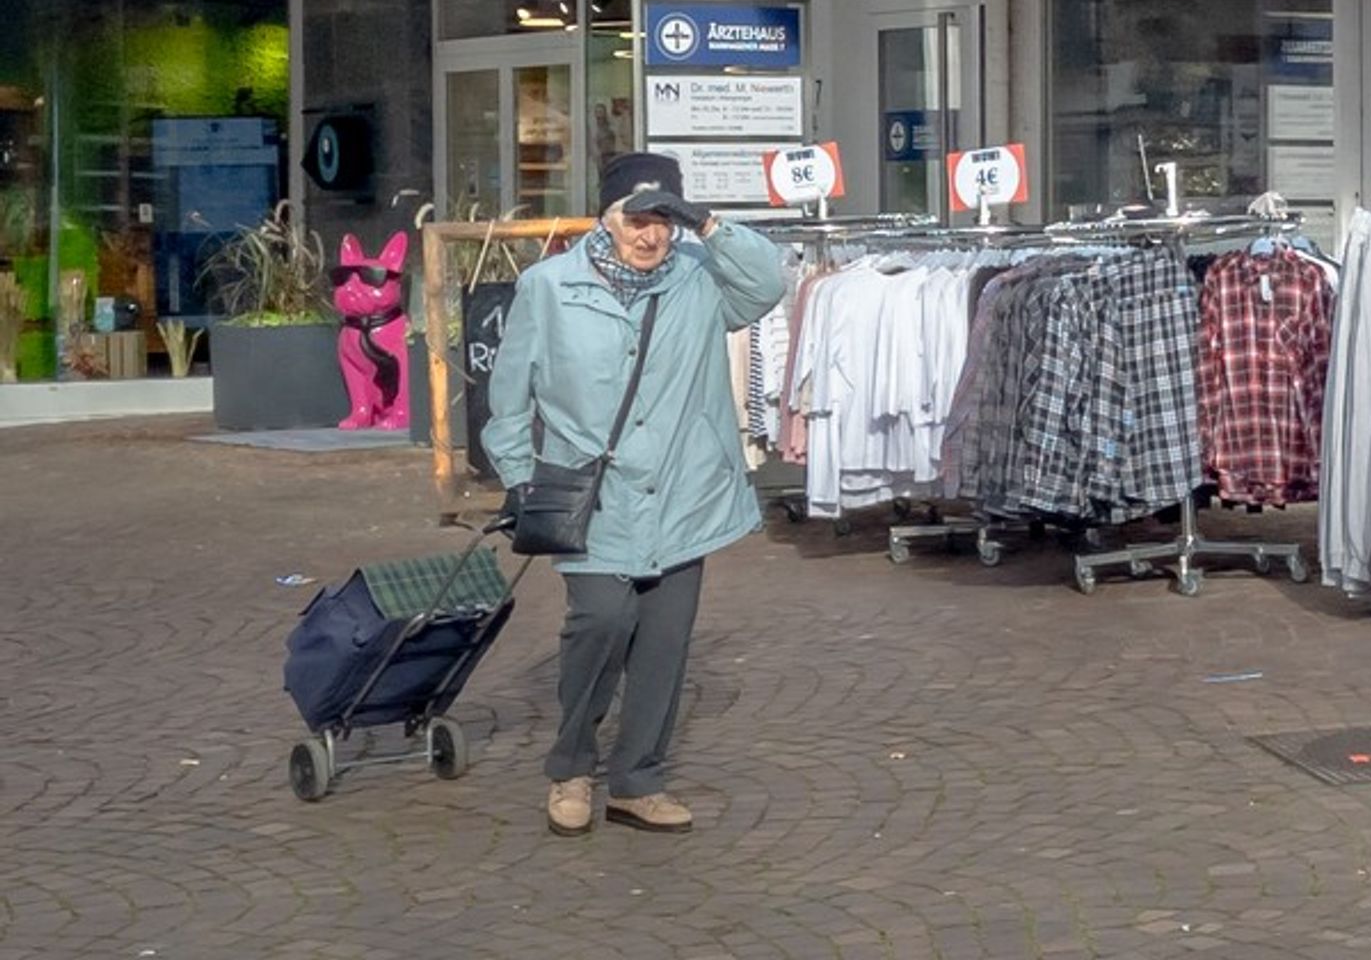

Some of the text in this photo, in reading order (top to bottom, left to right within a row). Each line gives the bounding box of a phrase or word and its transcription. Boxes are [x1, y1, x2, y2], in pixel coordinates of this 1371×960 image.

[707, 21, 786, 41] ÄRZTEHAUS
[791, 165, 815, 184] 8€
[976, 166, 999, 186] 4€
